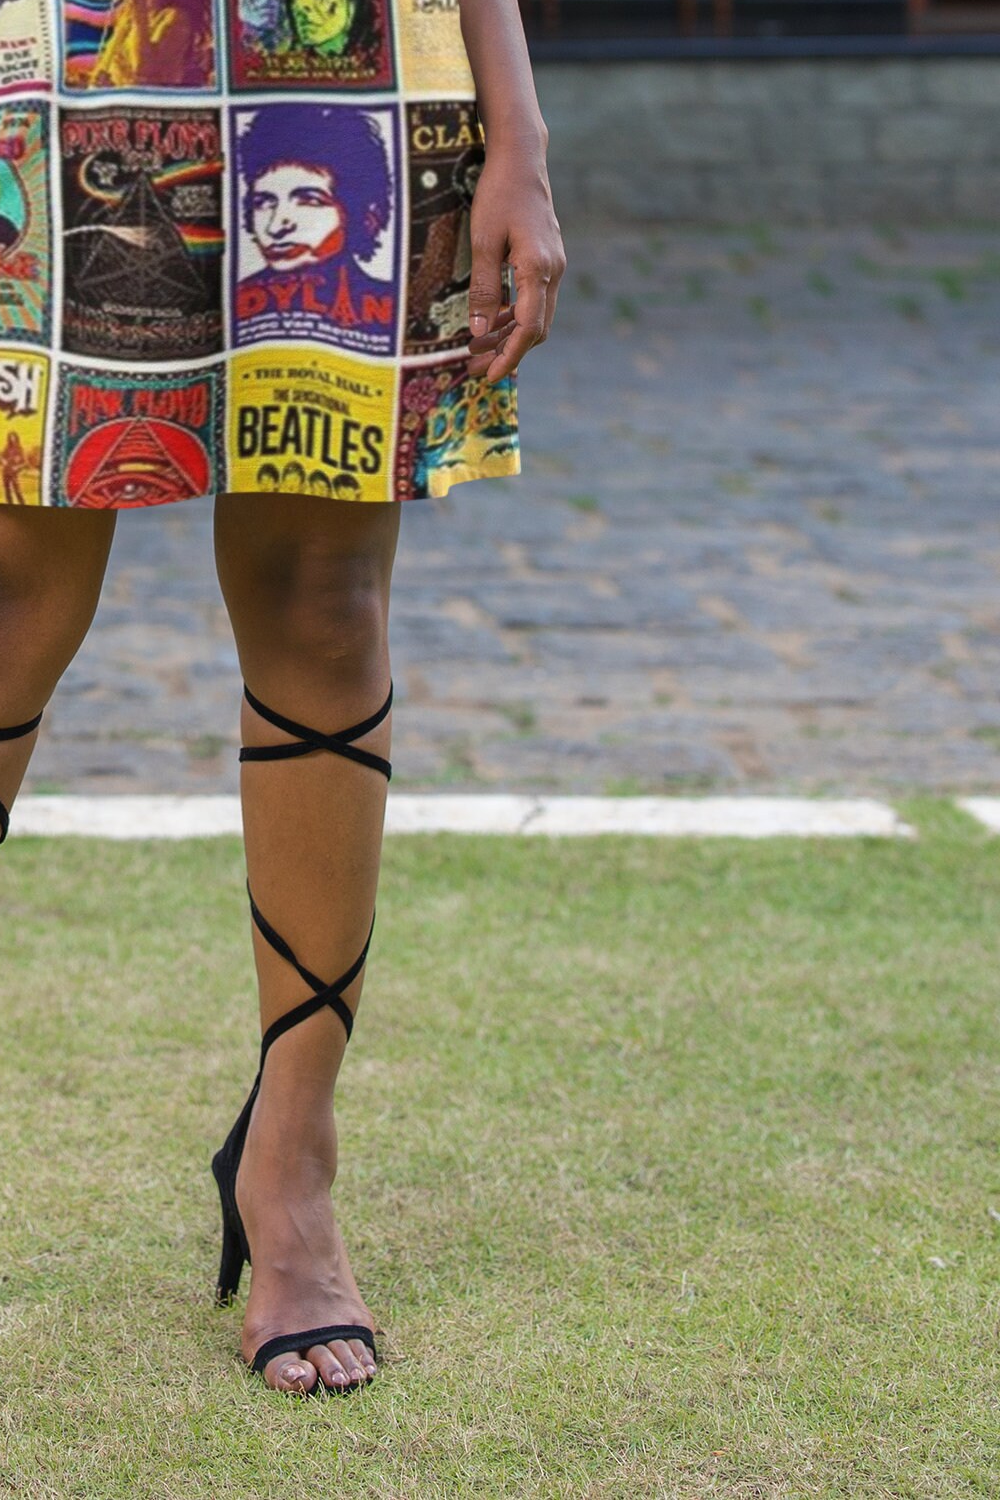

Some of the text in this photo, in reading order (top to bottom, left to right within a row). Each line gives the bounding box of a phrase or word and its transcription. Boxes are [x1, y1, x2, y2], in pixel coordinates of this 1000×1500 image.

[62, 118, 130, 157] PINK
[135, 119, 220, 160] FLOYD
[412, 124, 484, 150] CLA
[236, 265, 393, 326] DYLAN
[255, 368, 375, 399] THE ROYAL HALL
[273, 388, 290, 402] THE
[70, 383, 210, 436] PINK FLOYD
[238, 405, 384, 475] BEATLES
